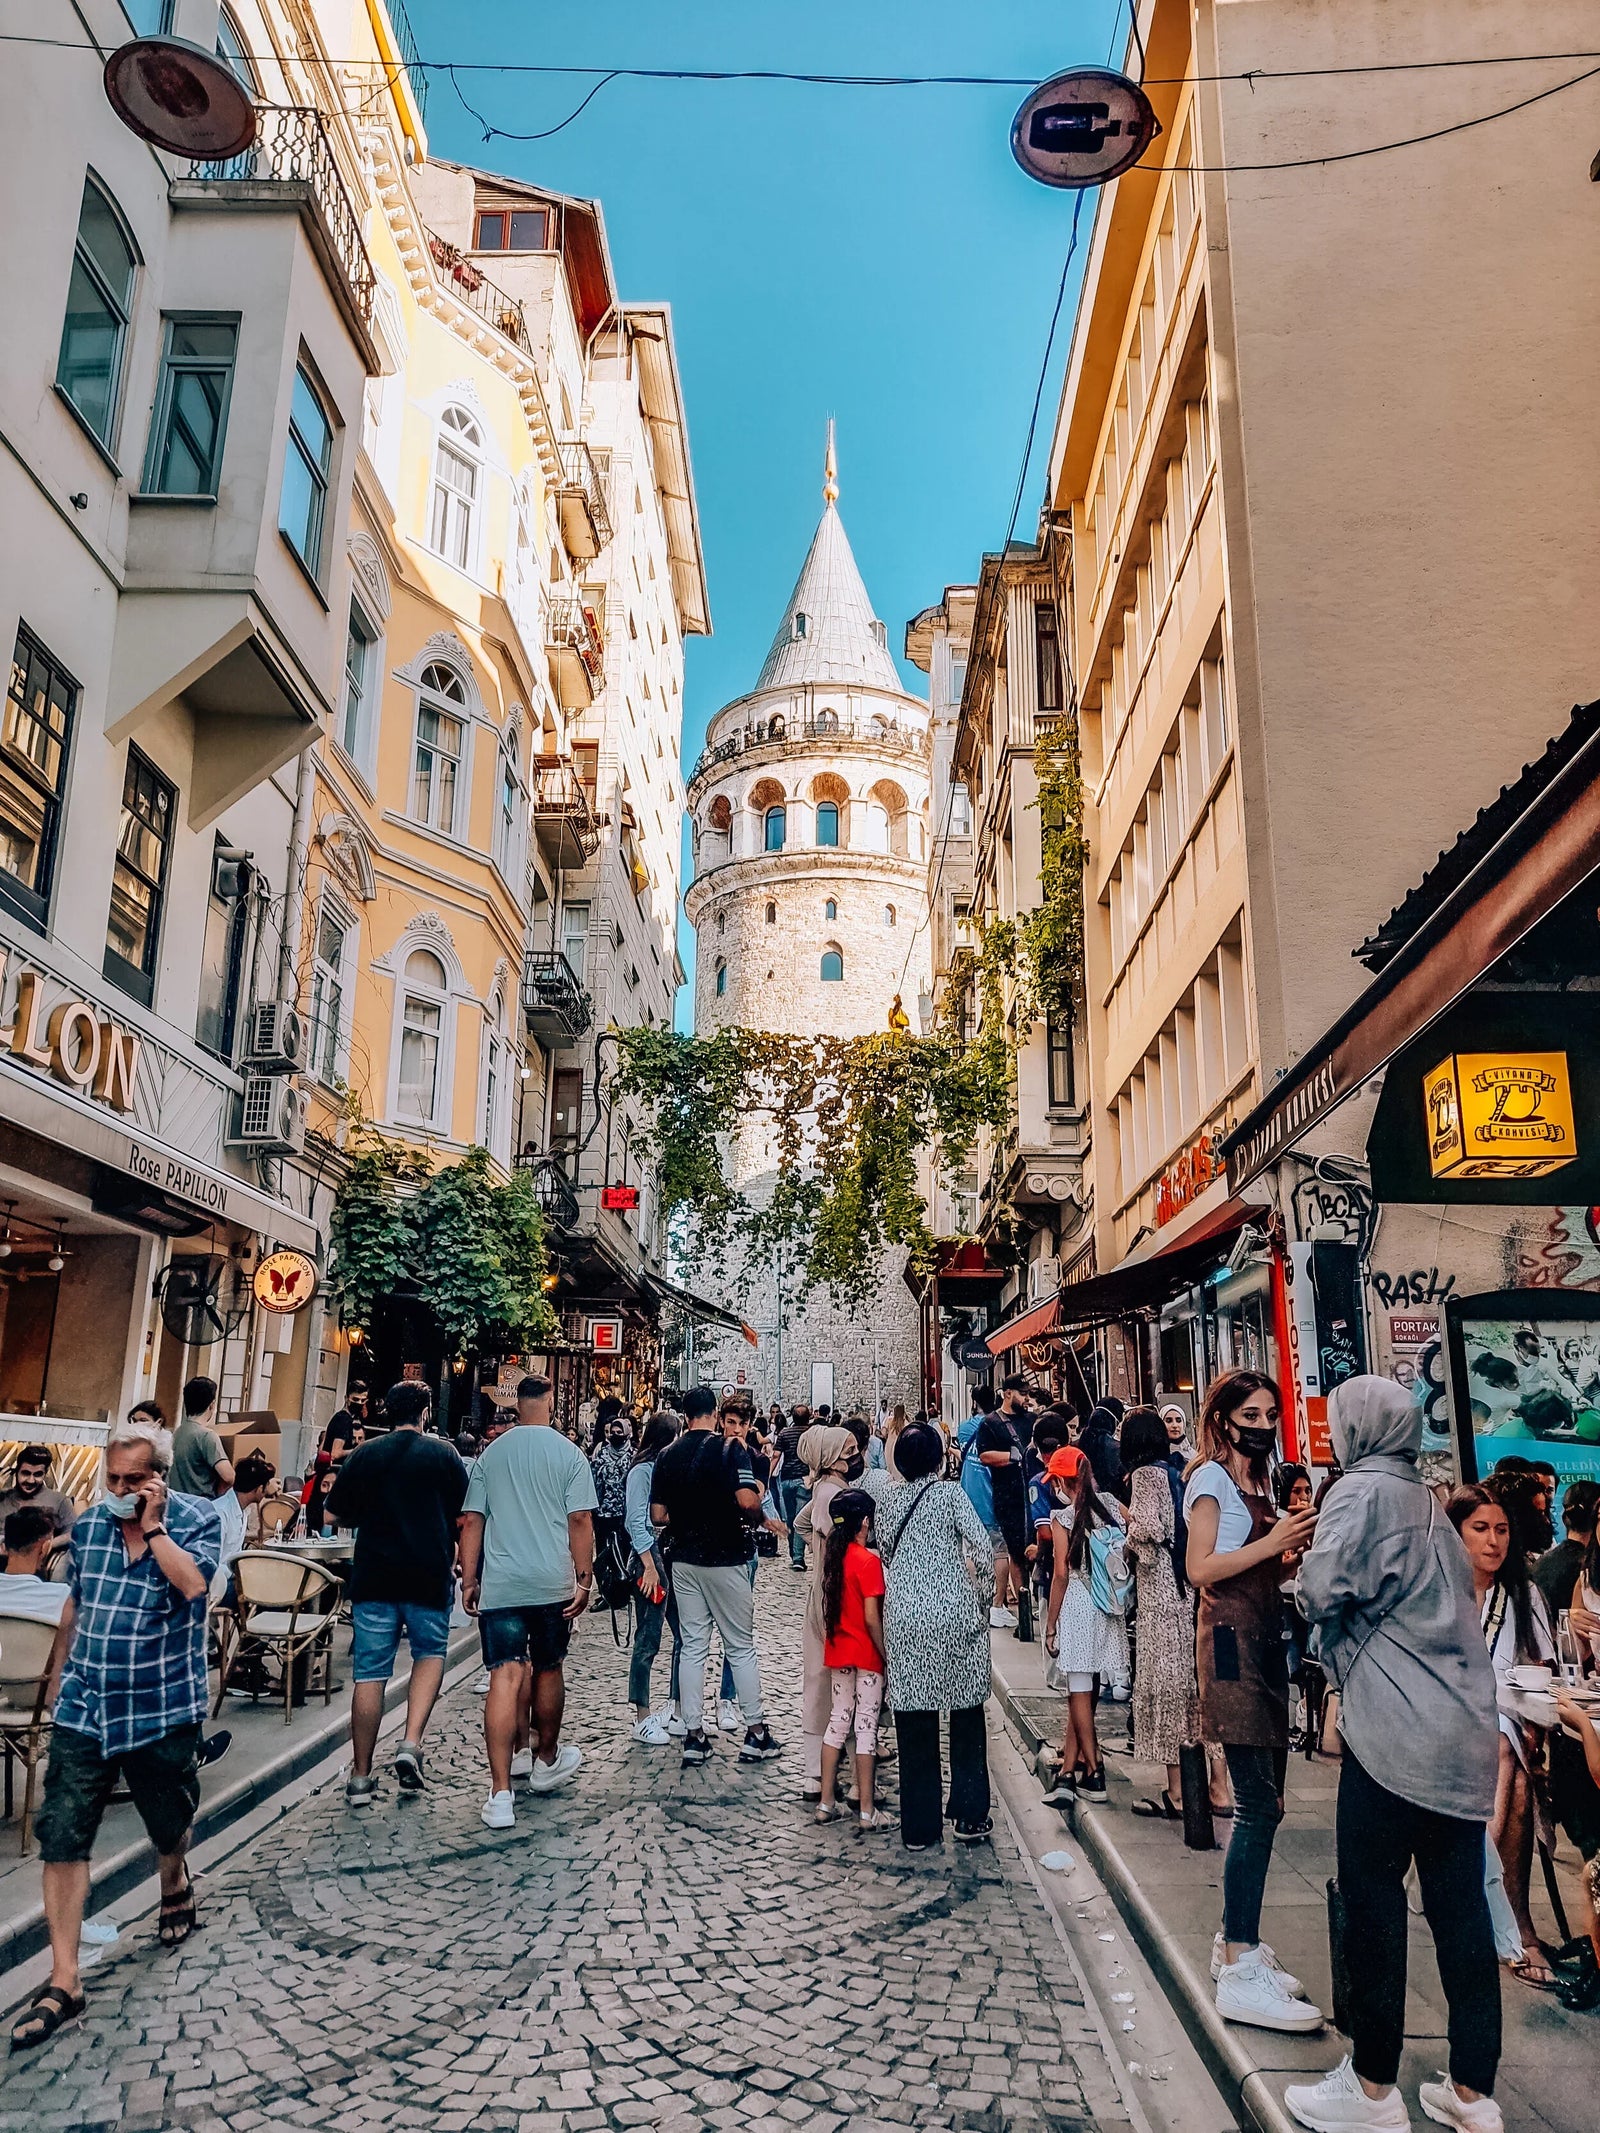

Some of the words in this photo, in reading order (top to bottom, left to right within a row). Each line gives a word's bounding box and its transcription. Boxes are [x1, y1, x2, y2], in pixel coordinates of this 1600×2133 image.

[129, 1143, 161, 1181] Rose
[165, 1161, 228, 1212] PAPILLON
[260, 1257, 278, 1276] ROSE
[279, 1254, 315, 1277] PAPILLON
[1372, 1266, 1456, 1310] RASH
[596, 1326, 613, 1347] E
